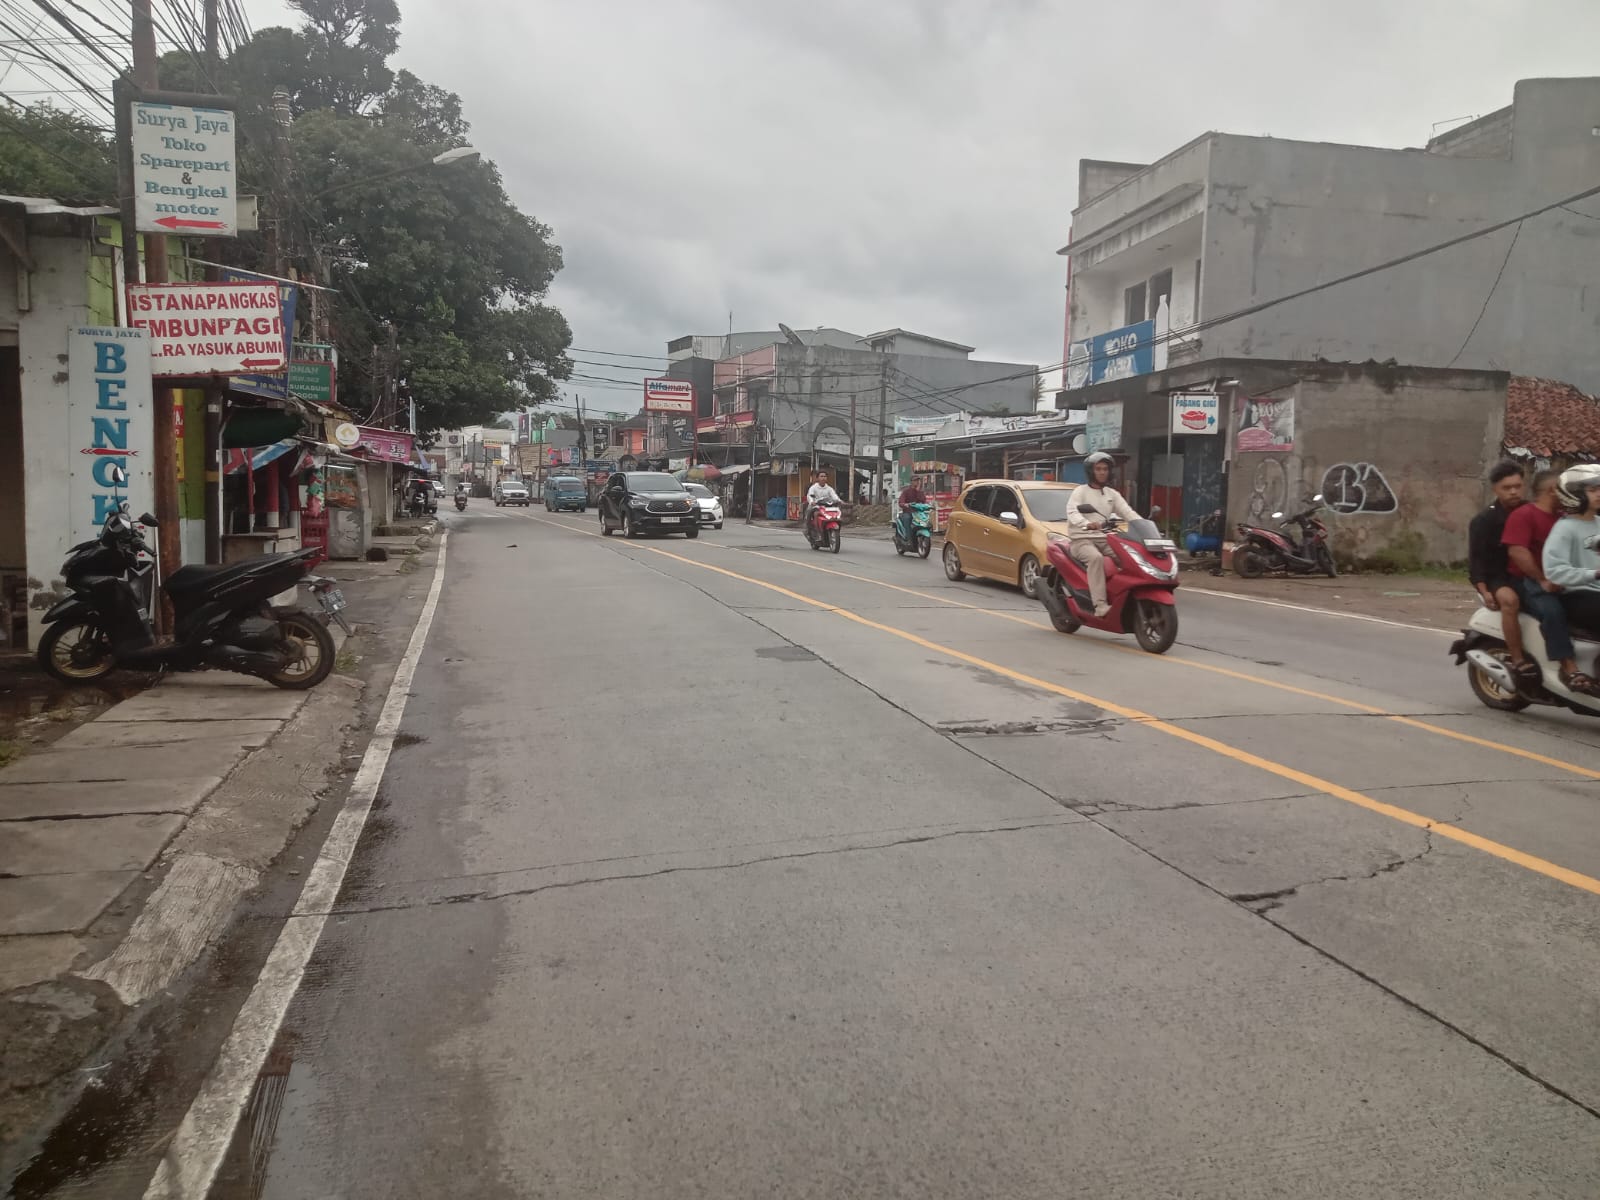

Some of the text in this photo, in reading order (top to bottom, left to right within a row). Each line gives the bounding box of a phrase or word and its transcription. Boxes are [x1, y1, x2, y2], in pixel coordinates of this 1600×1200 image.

[137, 109, 230, 135] Surya Jaya
[161, 136, 206, 152] Toko
[140, 153, 231, 173] Sparepart
[181, 172, 192, 185] &
[144, 181, 229, 199] Bengkel
[155, 203, 219, 216] motor
[297, 392, 319, 400] OGOR
[91, 341, 128, 538] BENGK
